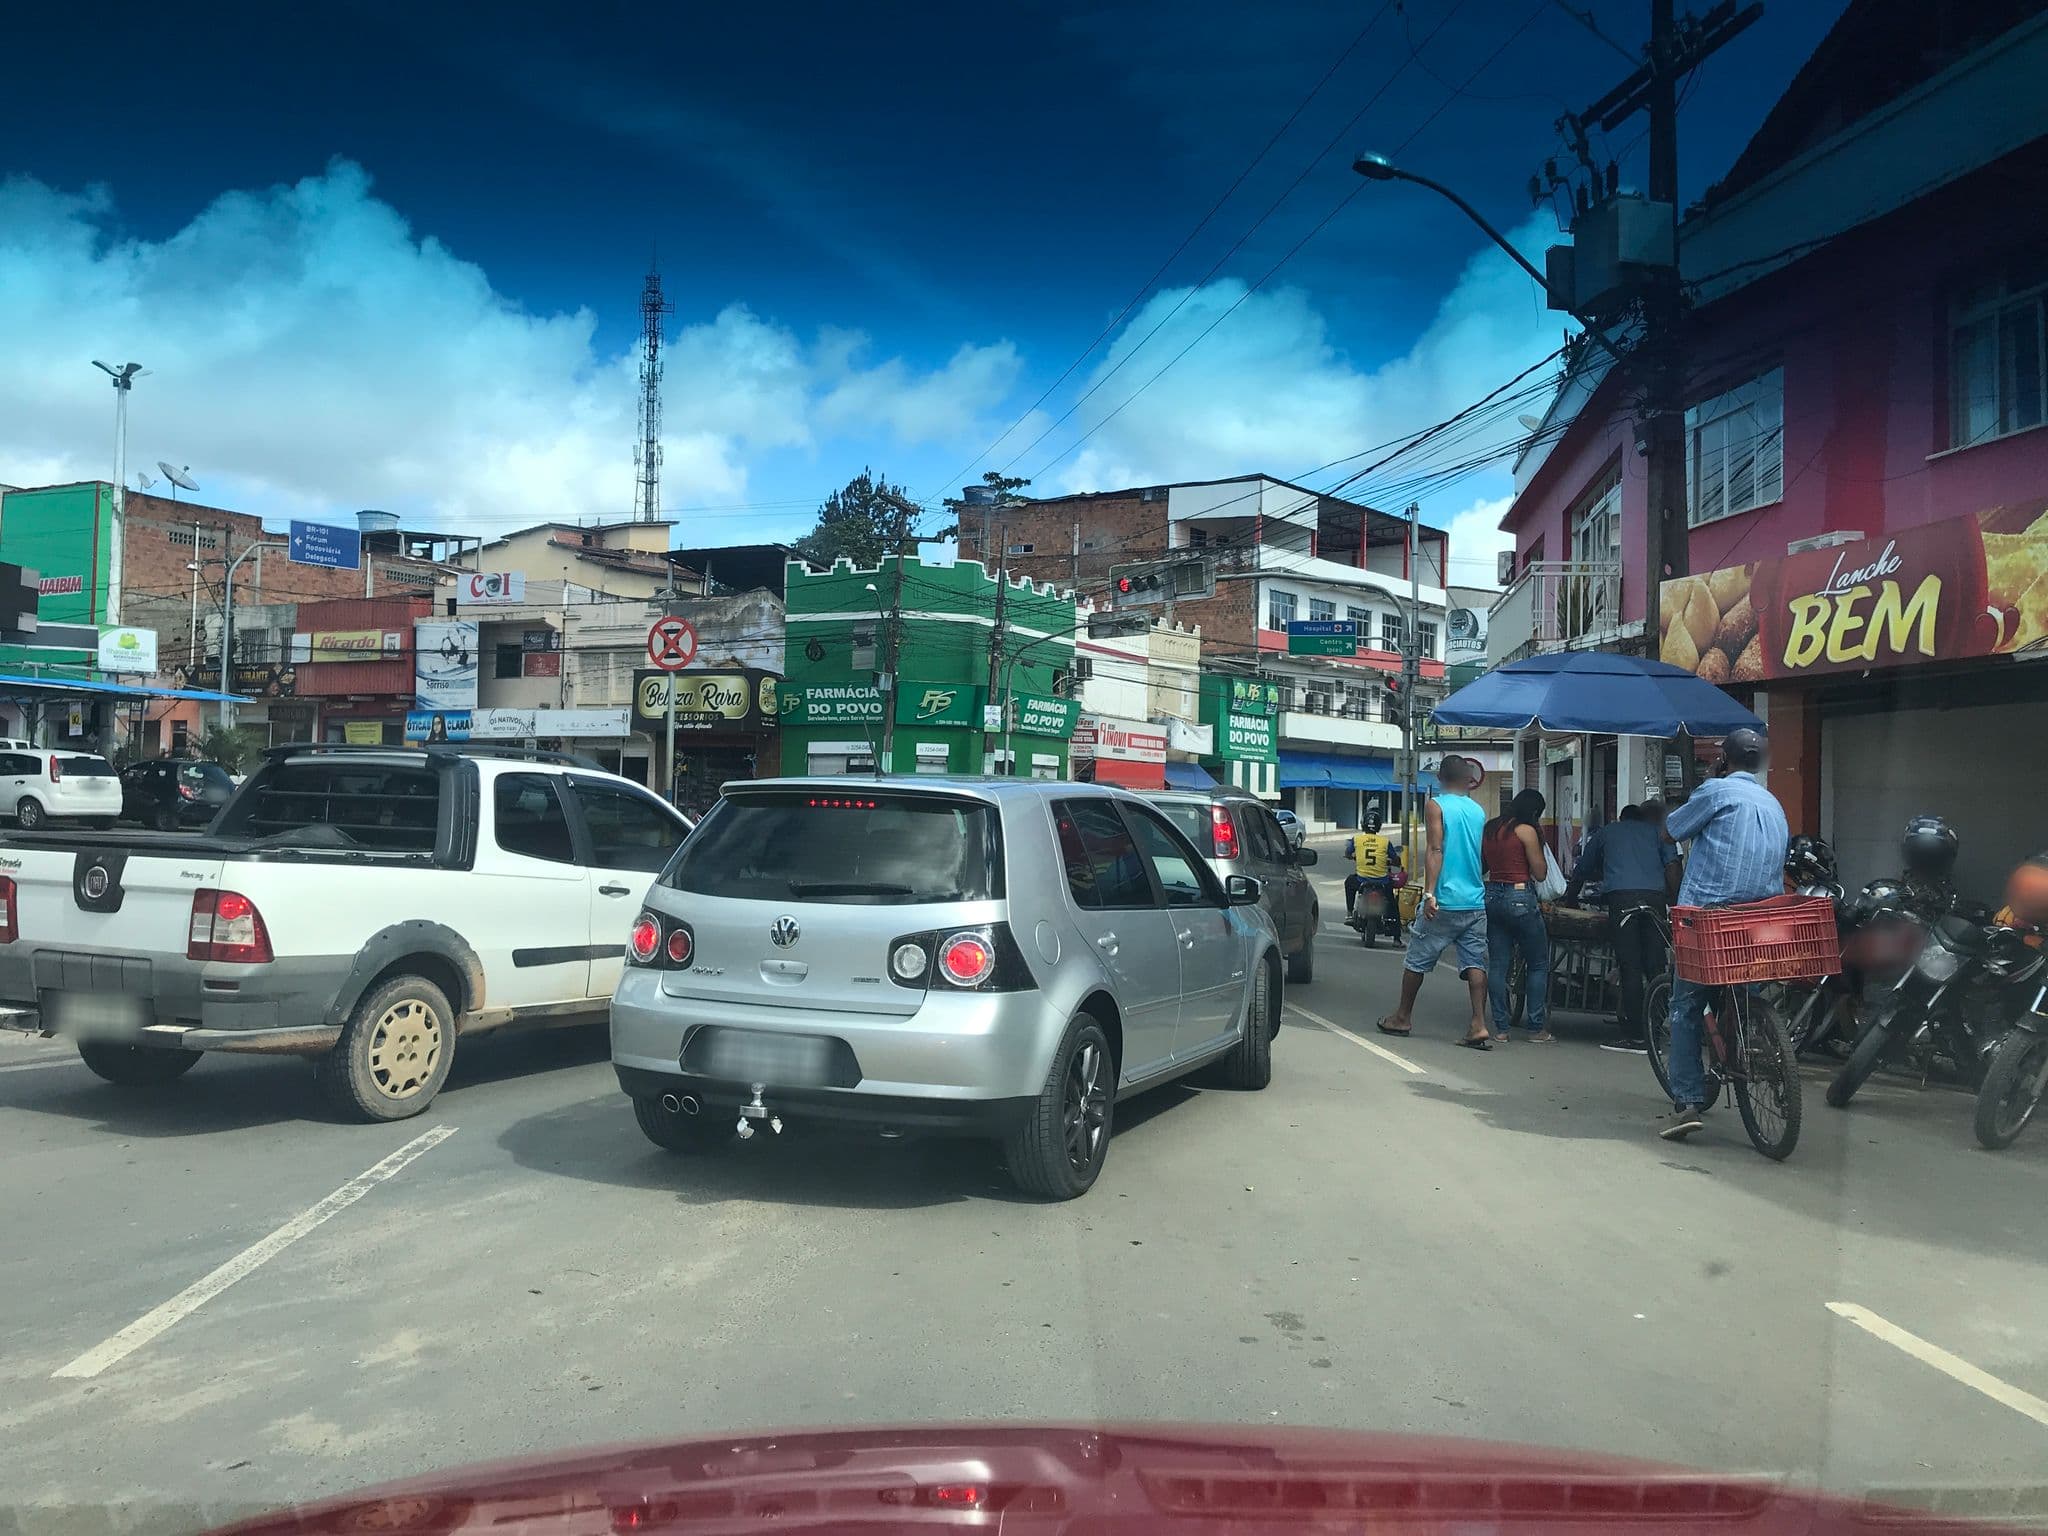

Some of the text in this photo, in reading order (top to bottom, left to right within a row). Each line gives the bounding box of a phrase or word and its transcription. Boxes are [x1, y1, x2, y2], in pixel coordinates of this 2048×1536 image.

[306, 525, 329, 534] BR-101
[305, 553, 337, 562] Delegacia
[1815, 540, 1902, 597] Lanche
[40, 576, 82, 595] UAIBIM
[1783, 574, 1942, 668] BEM
[645, 682, 695, 708] Belza
[700, 682, 743, 711] Rara
[806, 684, 880, 699] FARMÁCIA
[807, 702, 883, 714] DO POVO
[1027, 699, 1067, 715] FARMÁCIA
[1023, 713, 1065, 728] DO POVO
[1229, 715, 1270, 732] FARMÁCIA
[1229, 730, 1270, 746] DO POVO
[1365, 849, 1376, 865] 5
